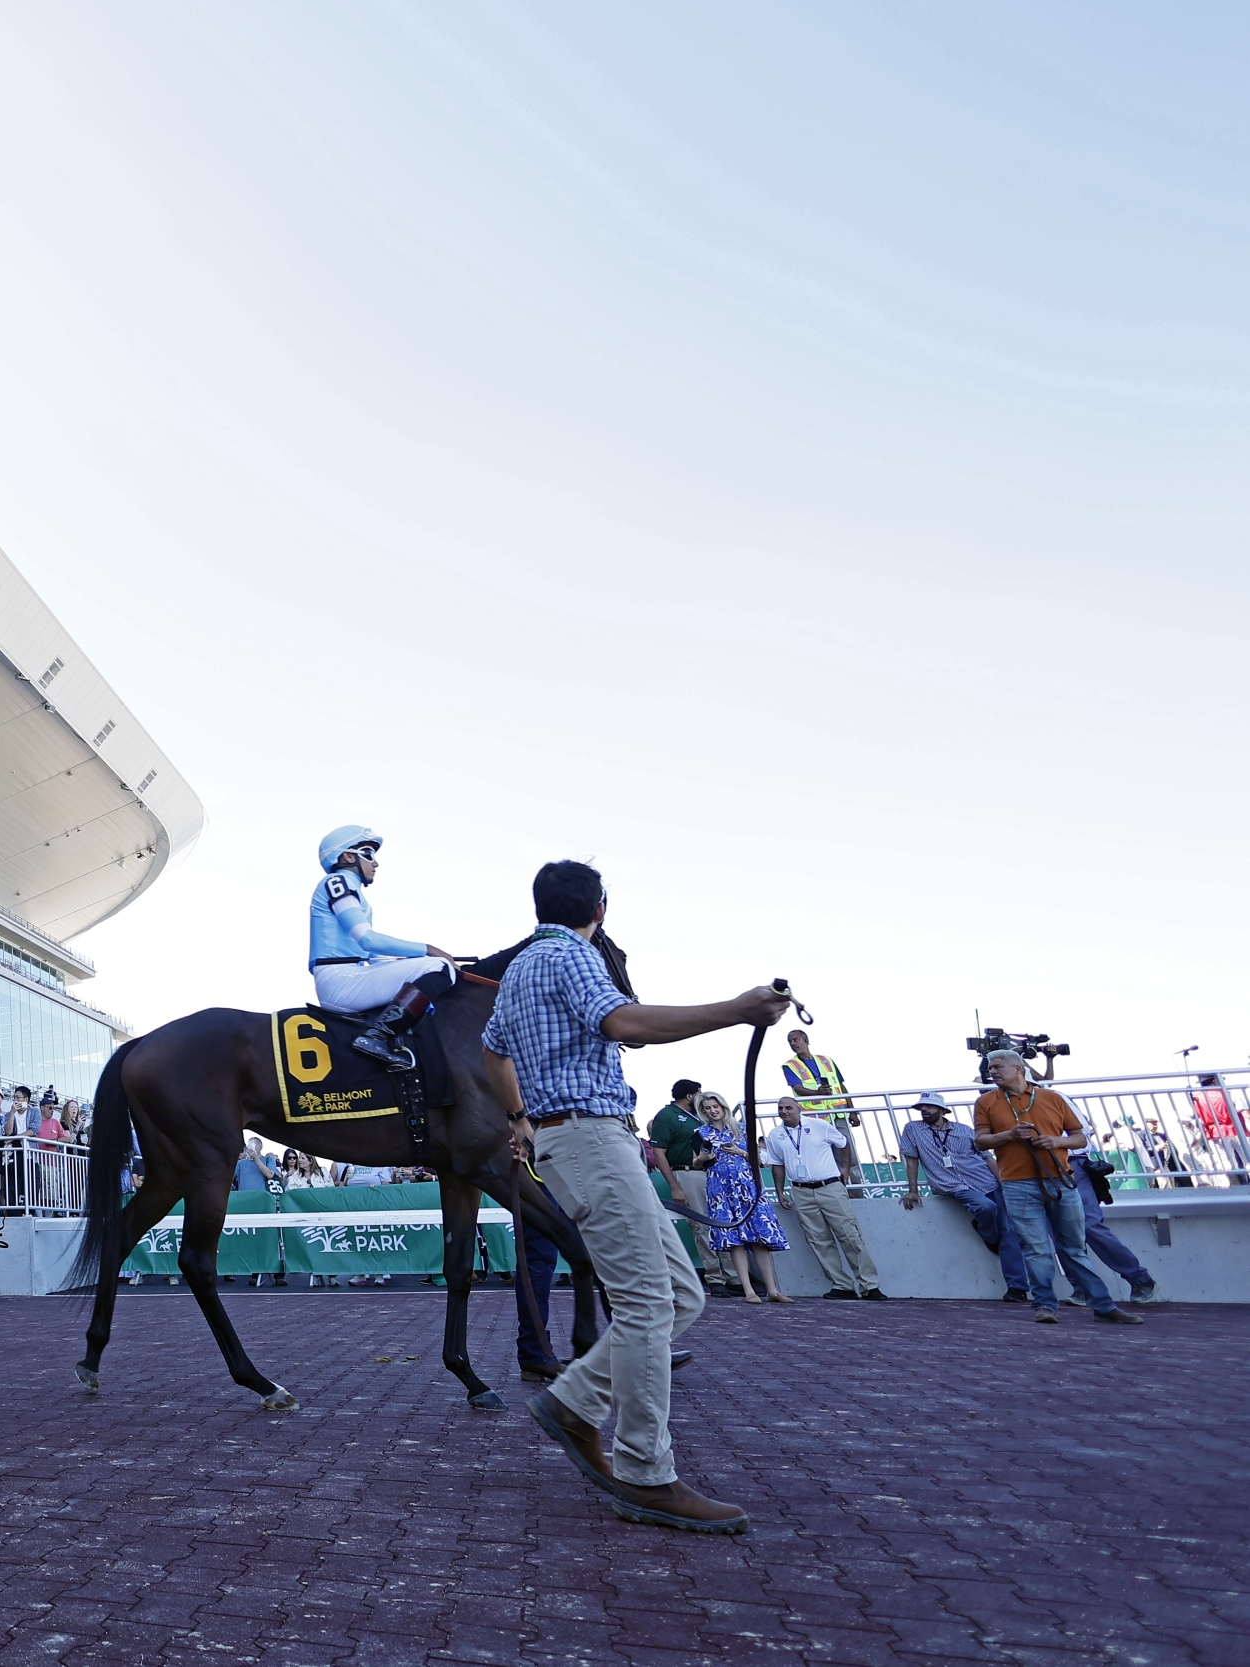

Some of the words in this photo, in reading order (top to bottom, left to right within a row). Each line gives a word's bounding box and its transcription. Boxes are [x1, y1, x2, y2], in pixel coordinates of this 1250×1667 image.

[327, 877, 345, 898] 6
[283, 1014, 332, 1084] 6
[323, 1089, 372, 1102] BELMONT
[325, 1101, 352, 1112] PARK
[267, 1179, 284, 1194] 26
[355, 1234, 408, 1252] PARK
